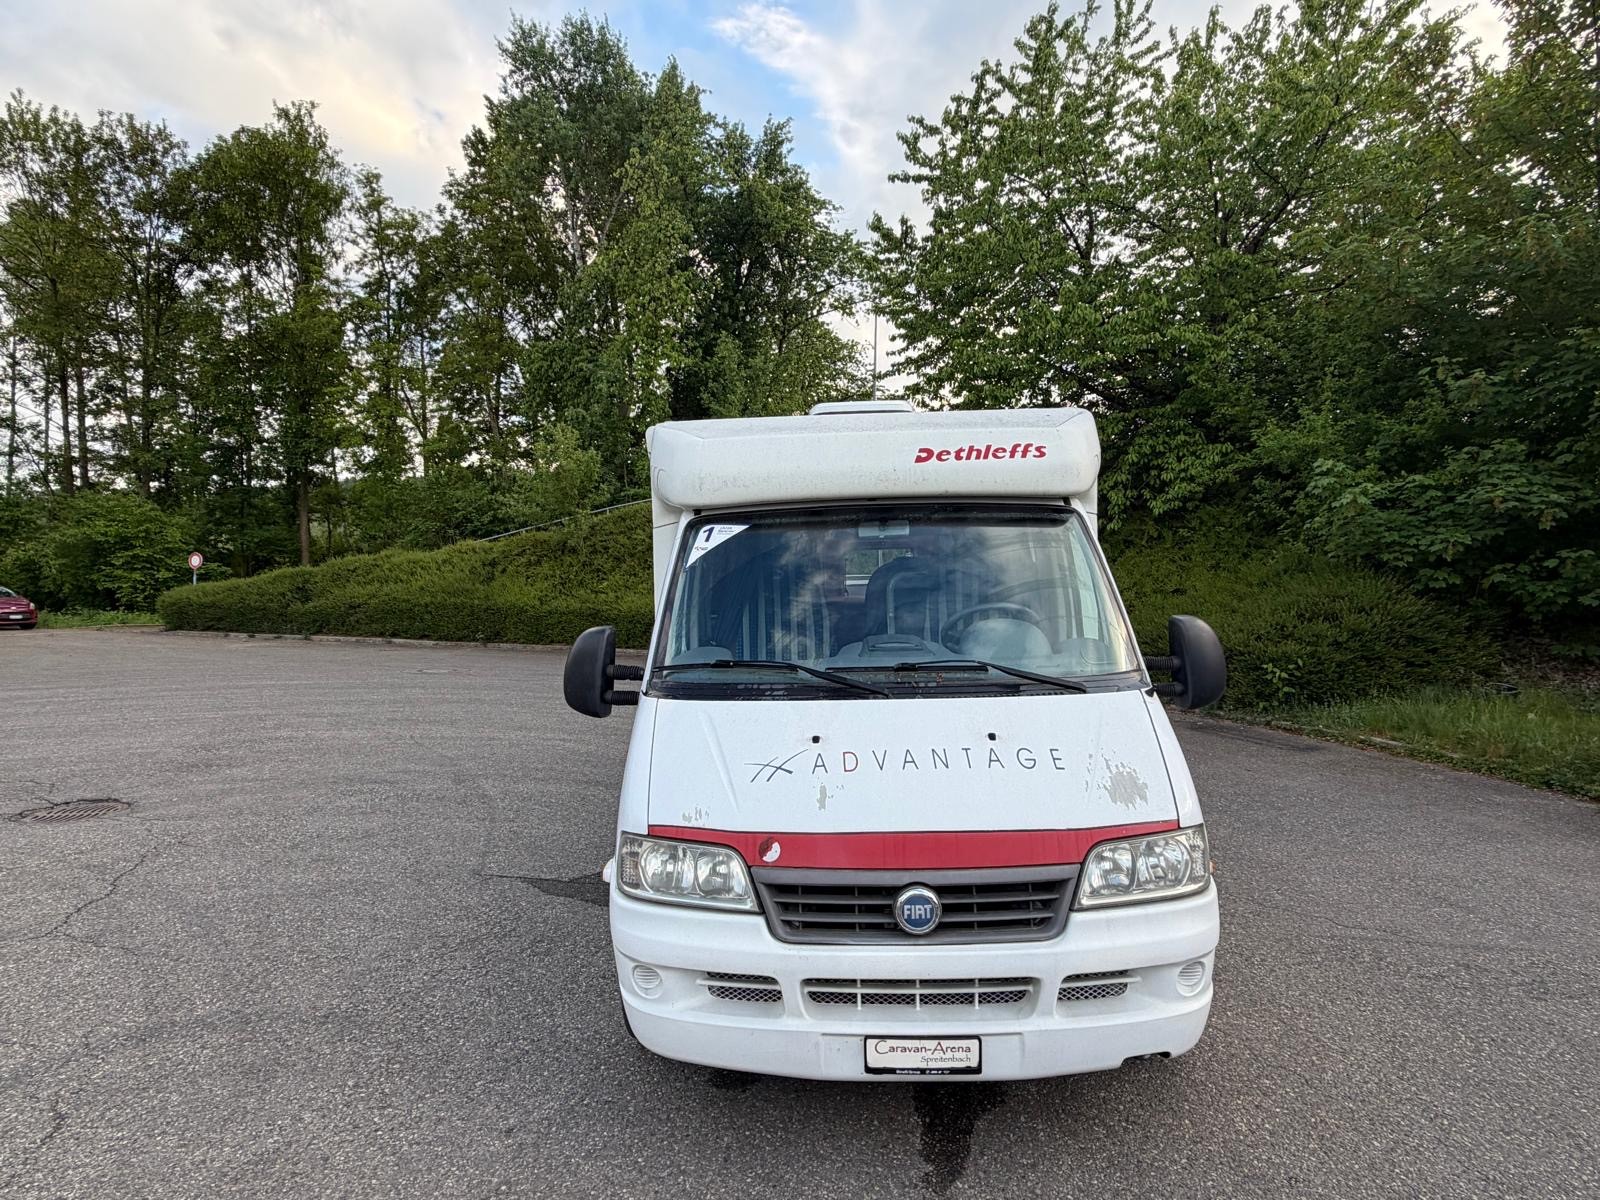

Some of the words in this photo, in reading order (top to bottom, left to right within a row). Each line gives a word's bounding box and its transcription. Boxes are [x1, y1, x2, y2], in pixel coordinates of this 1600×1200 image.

[914, 443, 1047, 463] Dethleffs
[703, 526, 715, 542] 1
[811, 747, 1066, 774] ADVANTAGE
[904, 905, 932, 919] FIAT
[874, 1040, 971, 1055] Caravan-Arena
[920, 1055, 971, 1065] Spreitenbach
